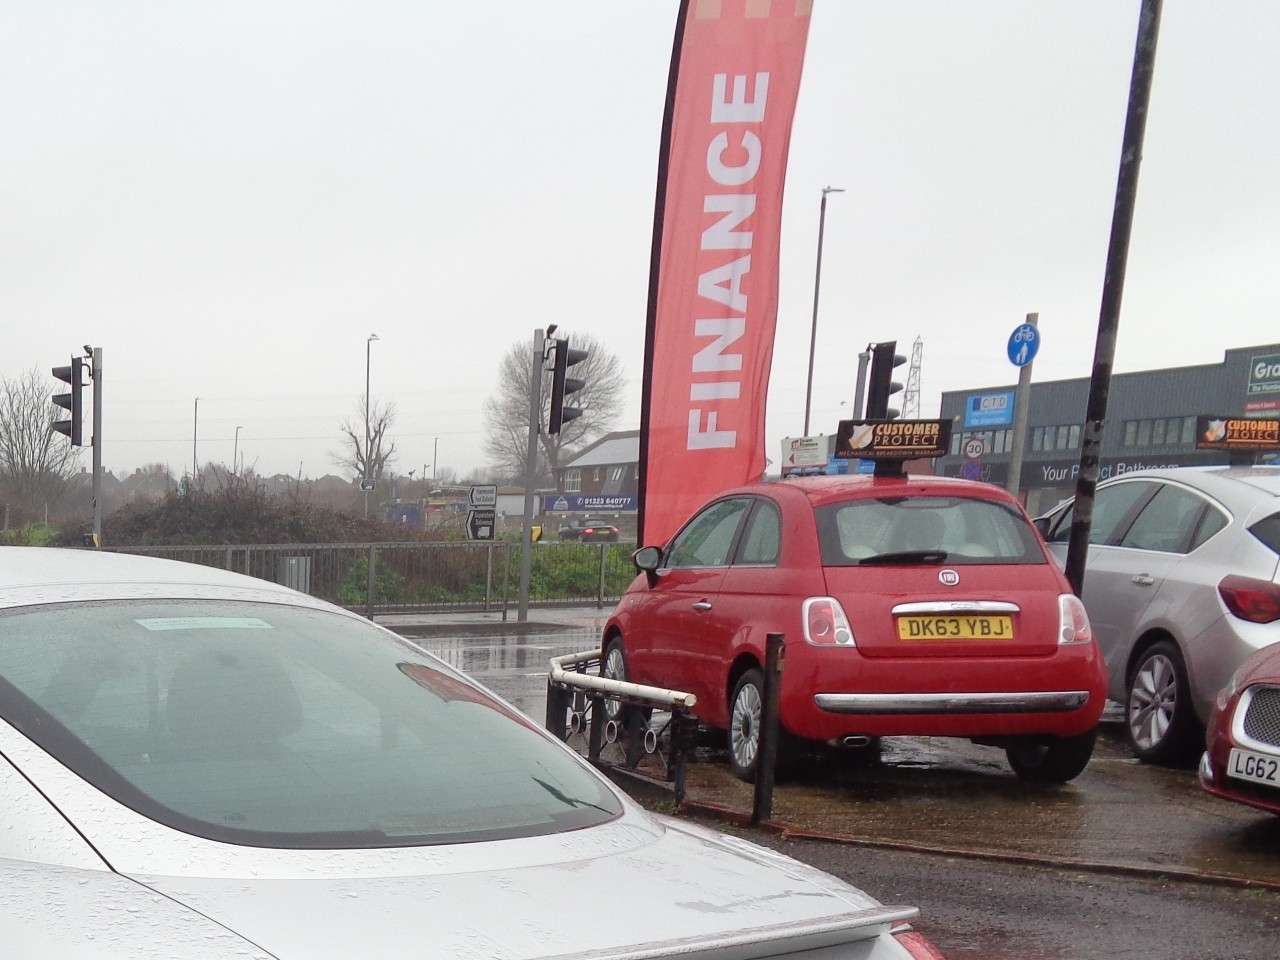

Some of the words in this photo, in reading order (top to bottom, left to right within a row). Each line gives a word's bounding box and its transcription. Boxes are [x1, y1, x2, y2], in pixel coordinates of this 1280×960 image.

[686, 71, 770, 450] FINANCE
[876, 423, 940, 436] CUSTOMER
[1227, 420, 1280, 431] CUSTOMER
[874, 435, 939, 446] PROTECT
[1227, 430, 1279, 440] PROTECT
[967, 444, 982, 454] 30
[1043, 465, 1067, 480] Your
[908, 619, 961, 636] DK63
[966, 619, 1005, 636] YBJ
[1235, 753, 1278, 780] LG62
